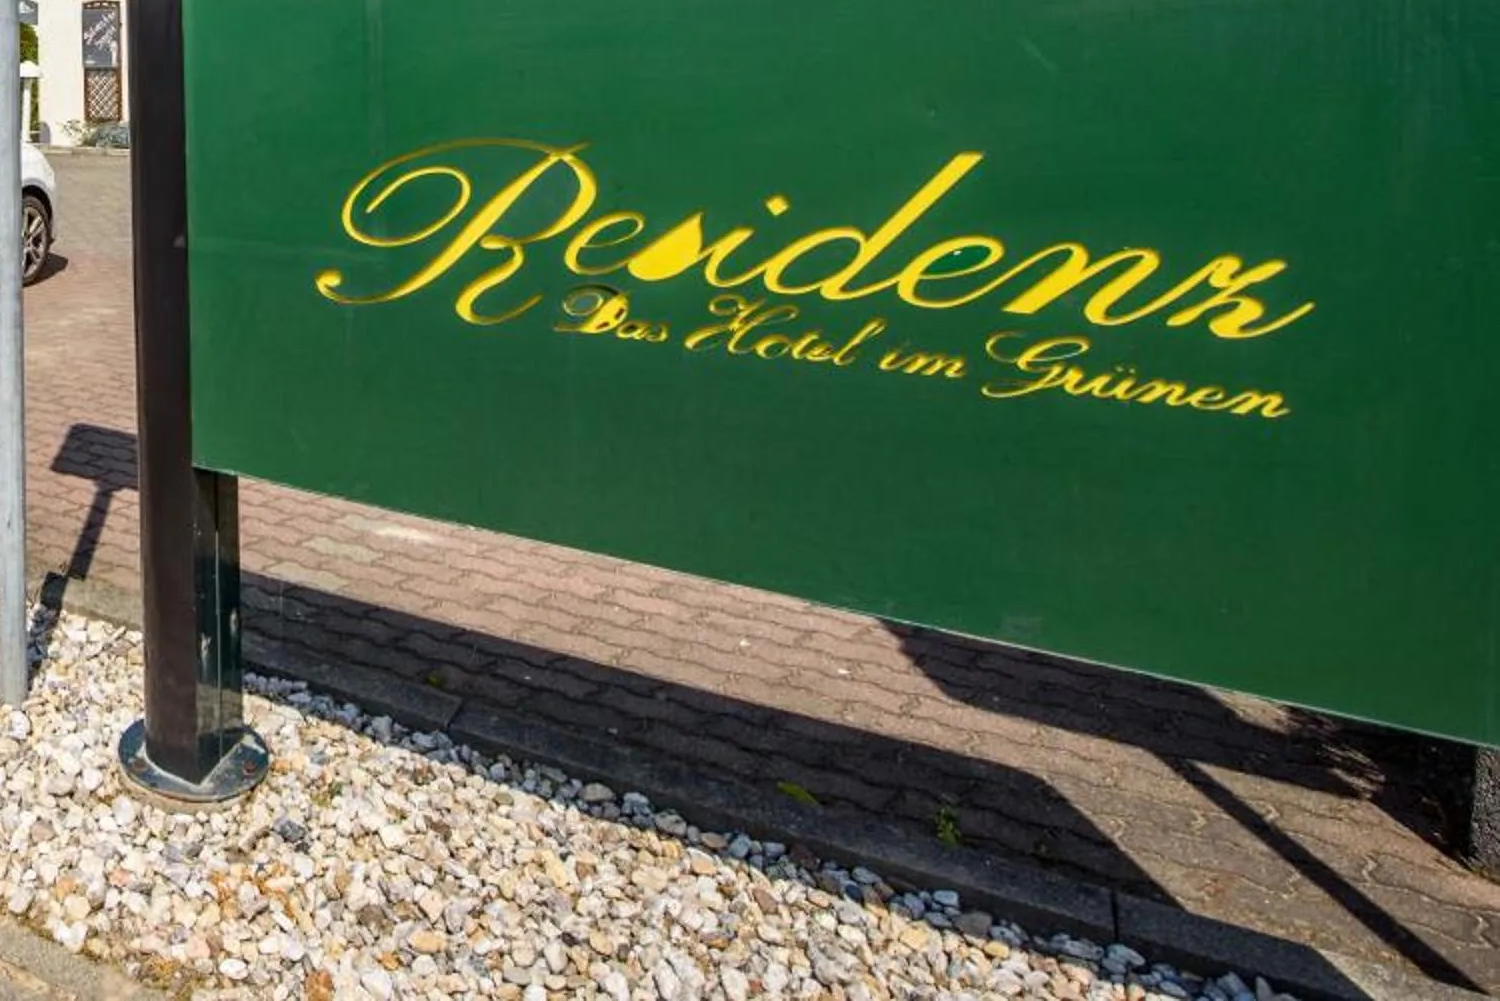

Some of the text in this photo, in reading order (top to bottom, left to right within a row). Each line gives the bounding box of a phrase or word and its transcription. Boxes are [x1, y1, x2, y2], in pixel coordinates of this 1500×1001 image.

[315, 137, 1315, 340] Residenz
[554, 283, 1291, 418] Das Hotel im Grünen
